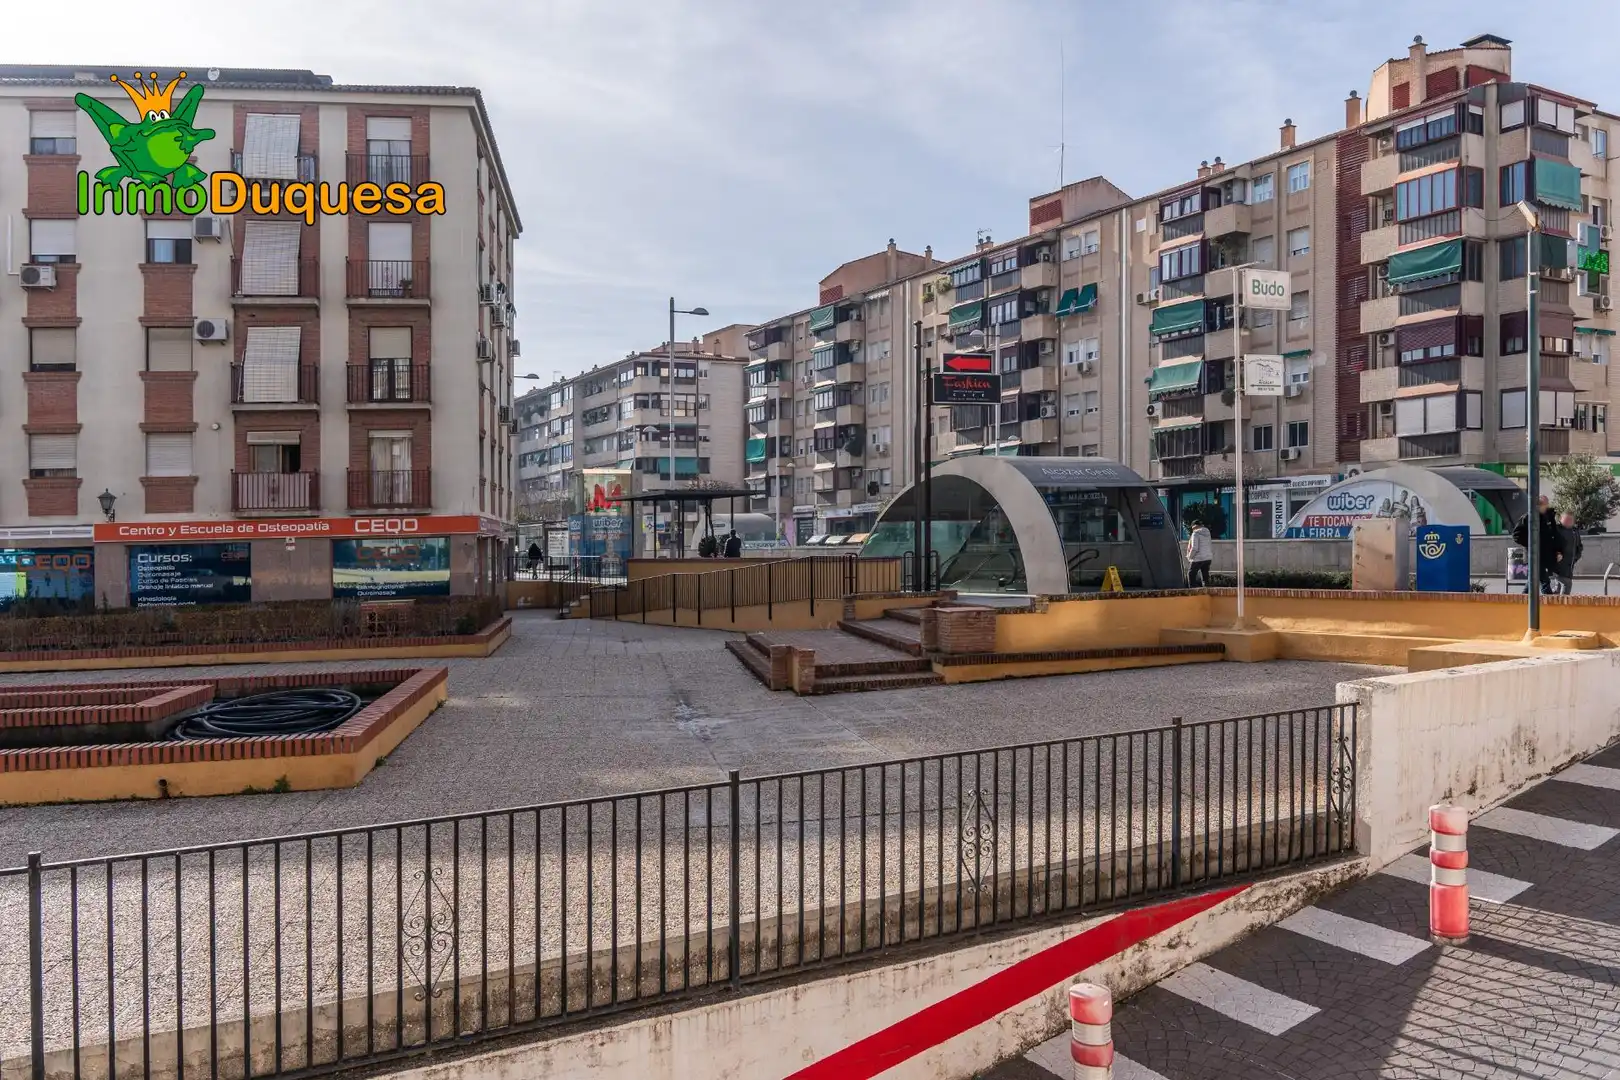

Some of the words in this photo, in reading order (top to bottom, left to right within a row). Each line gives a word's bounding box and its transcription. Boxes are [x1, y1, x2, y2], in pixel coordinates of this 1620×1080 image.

[1252, 279, 1285, 297] Budo
[1327, 492, 1375, 511] wiber
[354, 518, 418, 534] CEQO
[593, 517, 622, 528] wiber
[1308, 516, 1320, 527] TE
[1322, 515, 1366, 527] TOCAM
[119, 526, 165, 536] Centro
[168, 528, 177, 537] y
[180, 524, 234, 535] Escuela
[237, 523, 254, 533] de
[258, 520, 329, 534] Osteopatía
[1309, 528, 1341, 538] FIBRA
[137, 553, 193, 563] Cursos:
